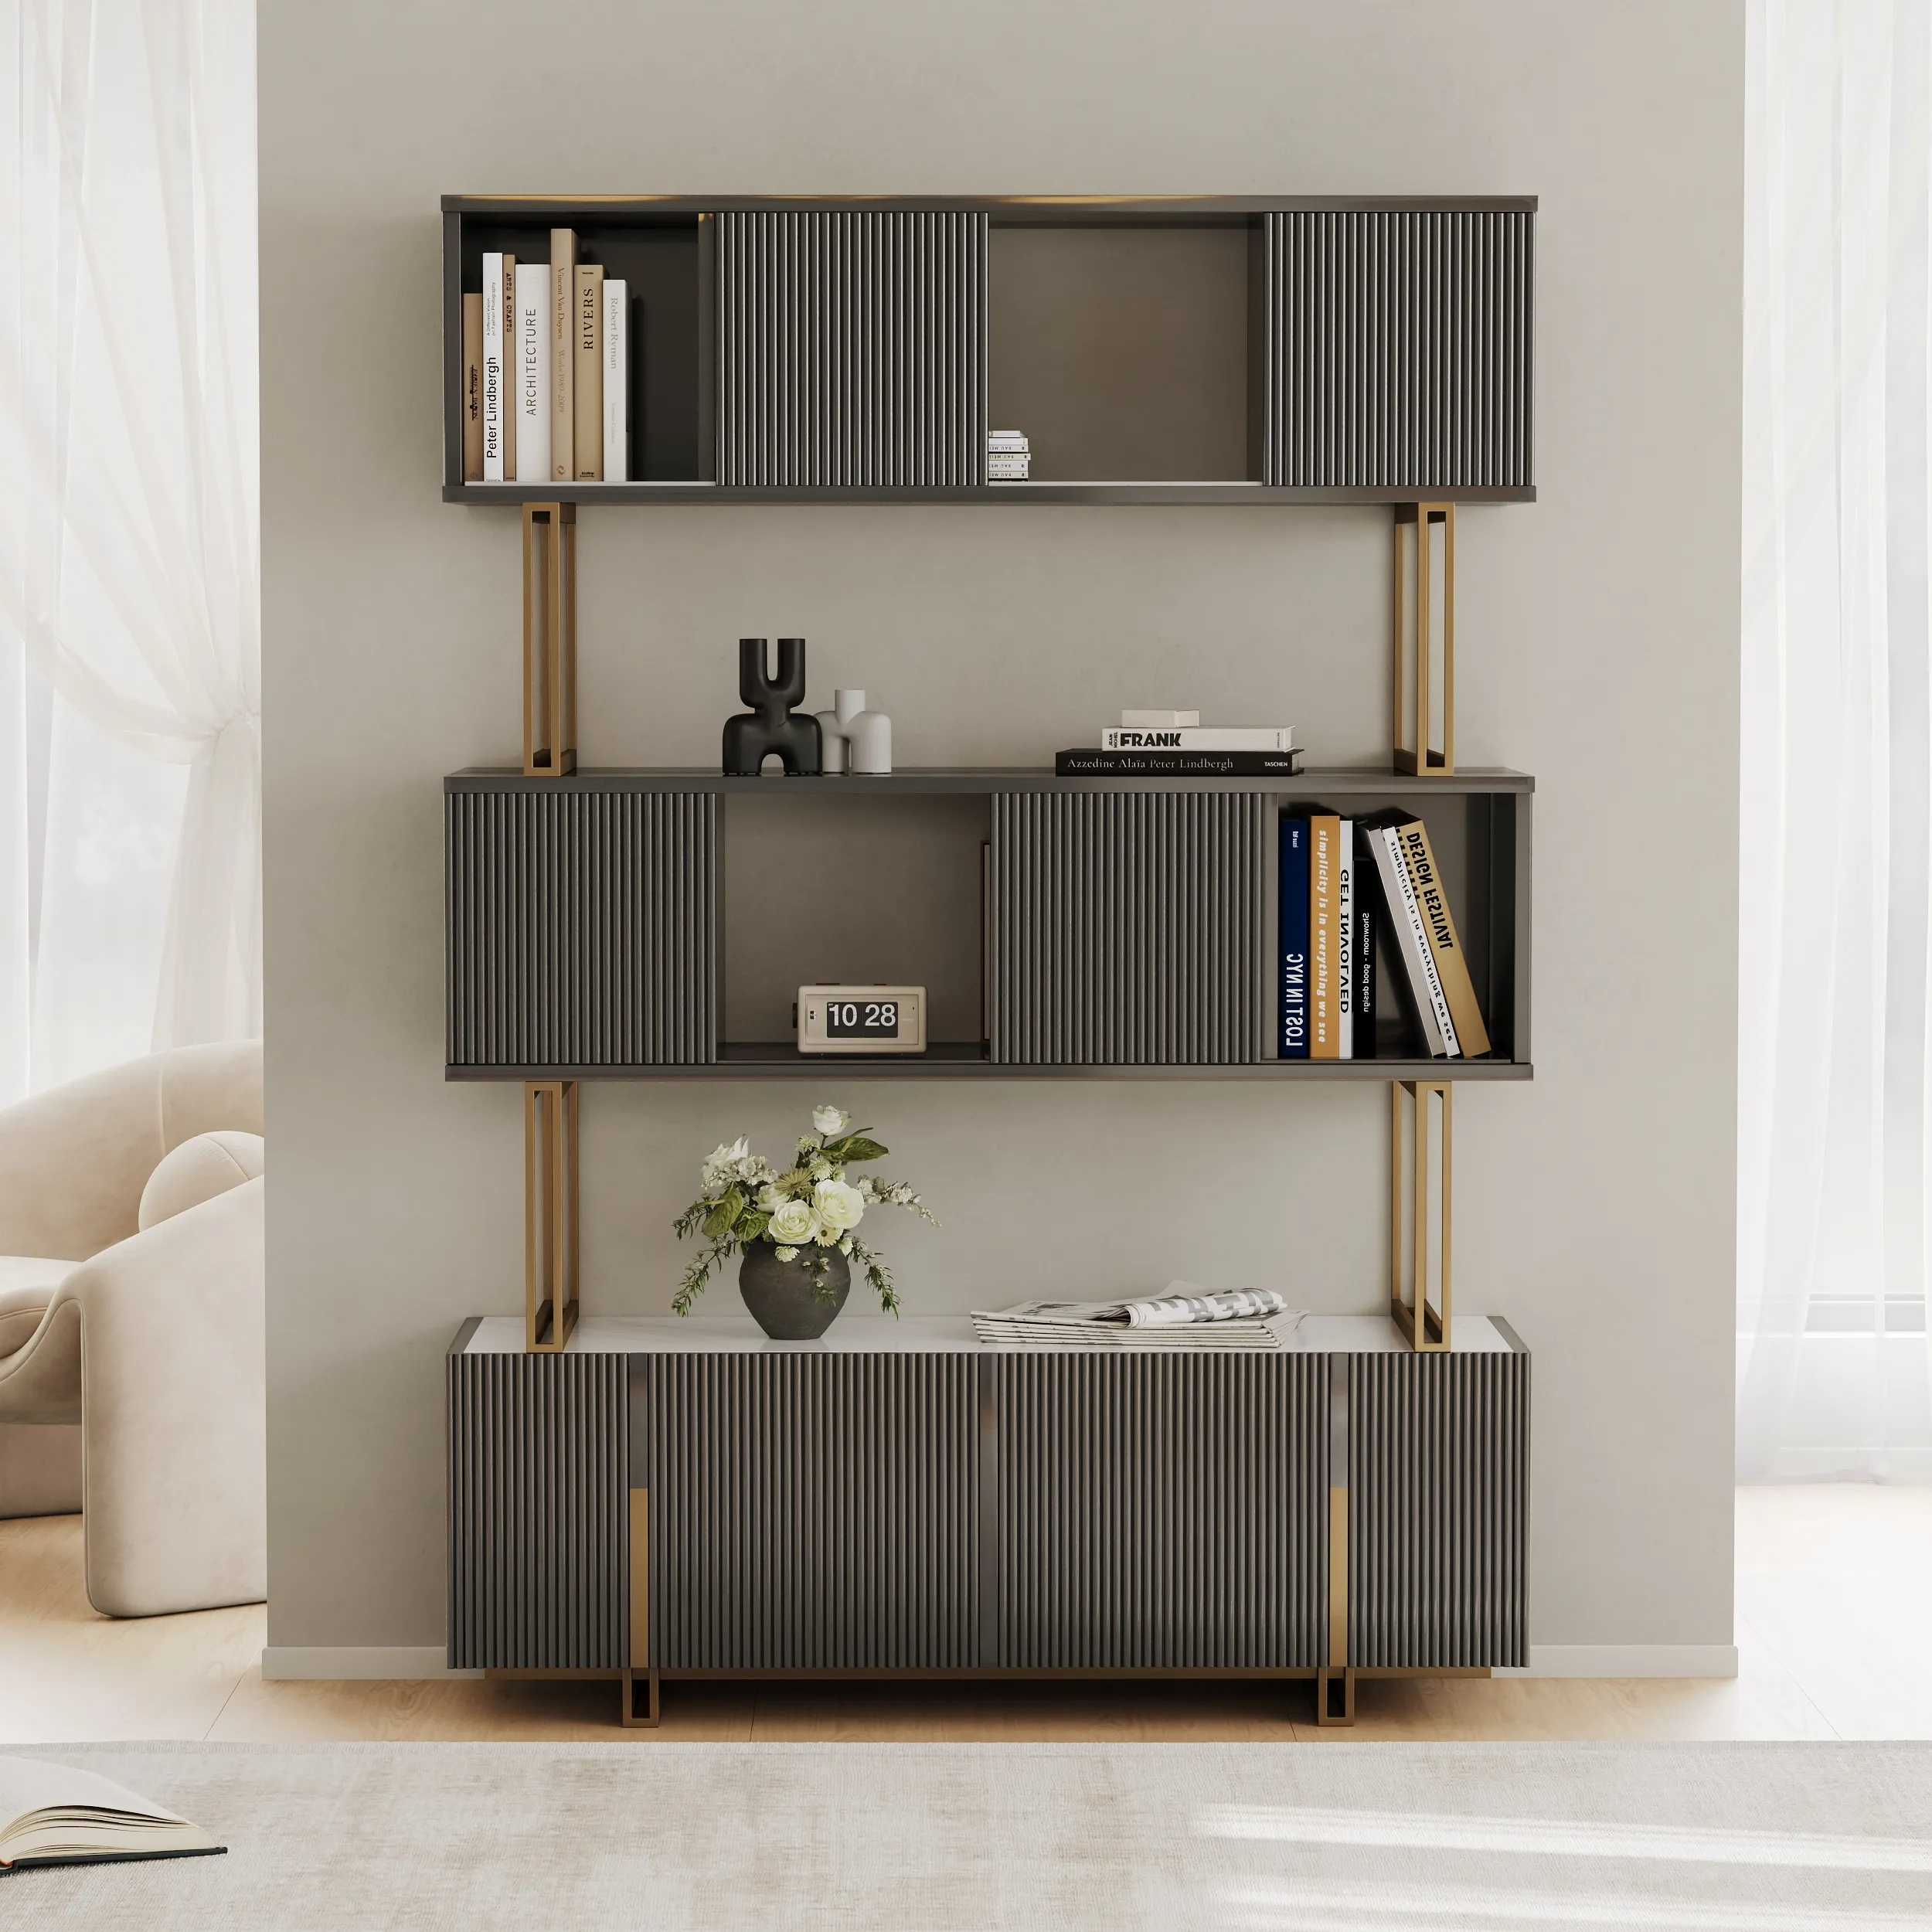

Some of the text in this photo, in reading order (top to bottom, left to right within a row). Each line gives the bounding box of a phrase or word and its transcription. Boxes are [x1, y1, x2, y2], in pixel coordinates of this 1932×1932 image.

[556, 313, 565, 339] Duysen
[583, 288, 594, 350] RIVERS
[526, 308, 536, 416] ARCHITECTURE
[609, 334, 618, 369] Ryman
[486, 357, 500, 458] Peter Lindbergh
[1120, 733, 1182, 747] FRANK
[1067, 757, 1233, 770] Azzedine Alaïa Peter Lindbergh
[1316, 829, 1328, 1043] simplicity is in everything we see
[829, 1004, 896, 1027] 10 28
